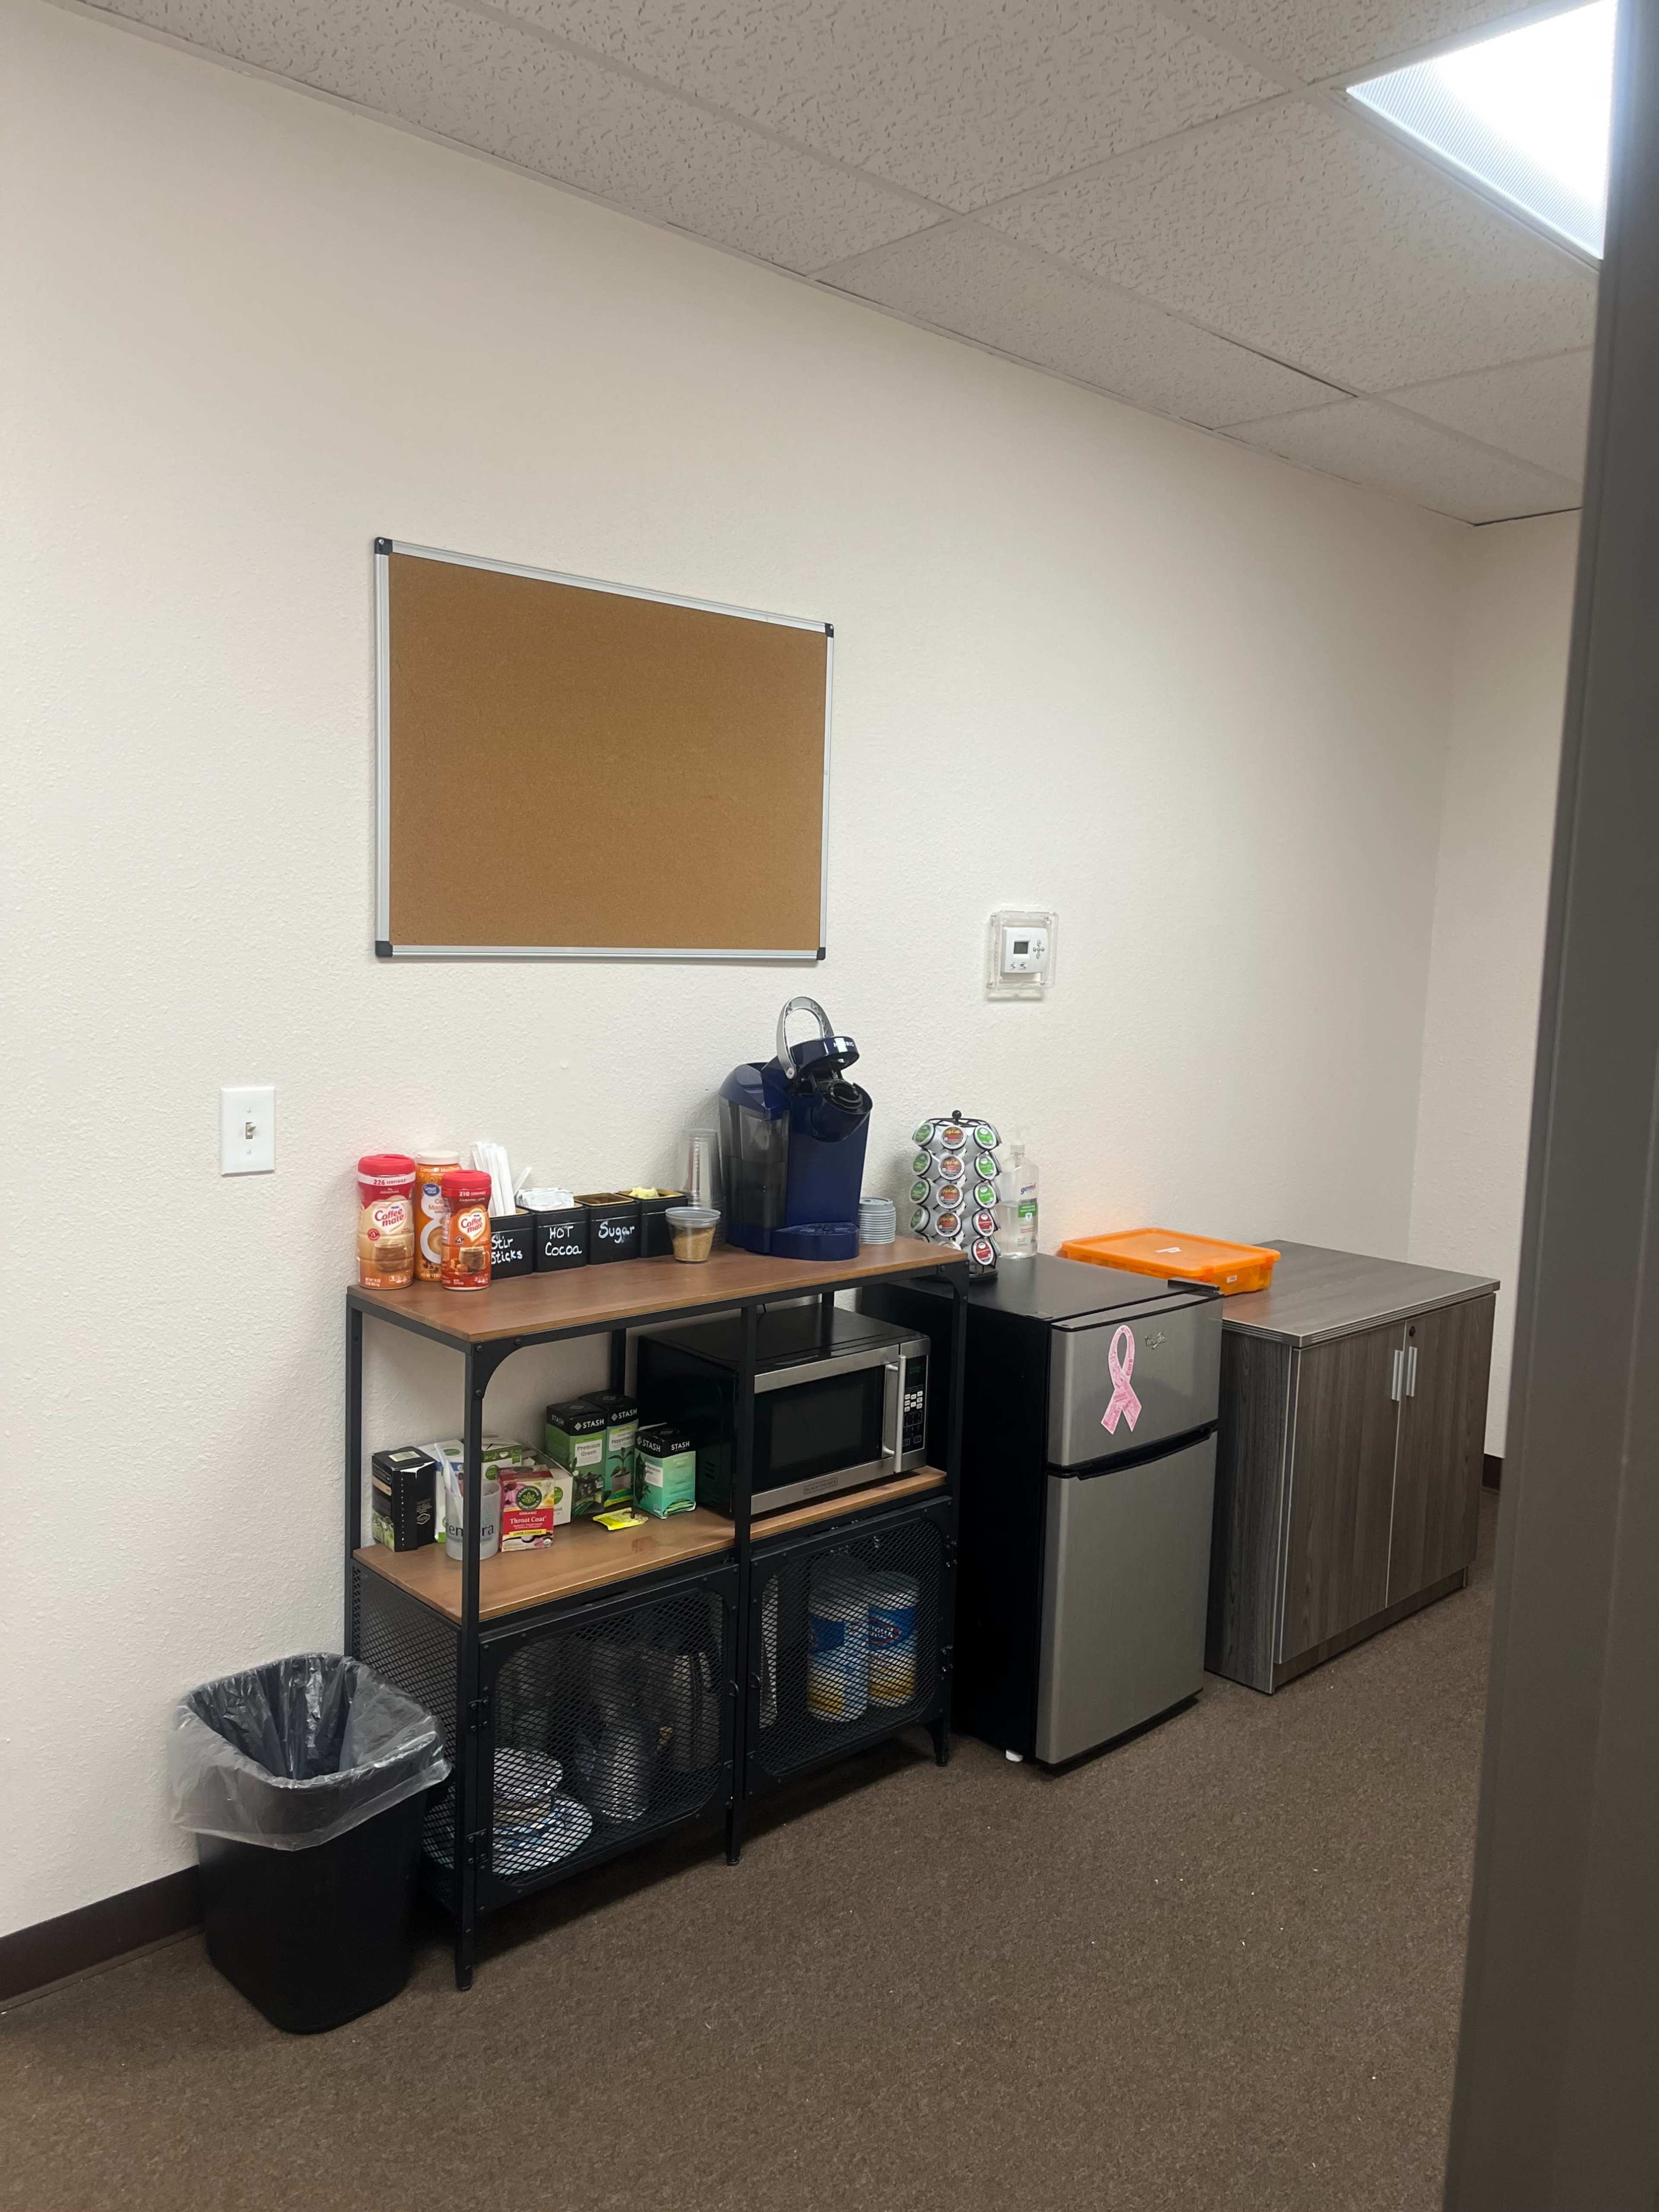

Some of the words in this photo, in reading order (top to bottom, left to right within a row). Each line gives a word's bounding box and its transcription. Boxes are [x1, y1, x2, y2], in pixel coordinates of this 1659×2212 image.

[375, 1208, 403, 1221] Coffee
[382, 1214, 404, 1227] mate
[461, 1217, 482, 1228] Coffee
[467, 1222, 483, 1233] mate
[550, 1225, 574, 1239] HOT
[598, 1220, 635, 1244] Sugar
[491, 1233, 513, 1249] Stir
[545, 1242, 582, 1256] Cocoa
[491, 1250, 523, 1265] Sticks
[552, 1414, 564, 1425] STASH
[618, 1408, 637, 1419] STASH
[582, 1419, 604, 1429] STASH
[577, 1443, 601, 1451] Premium
[642, 1440, 661, 1452] STASH
[671, 1441, 690, 1450] STASH
